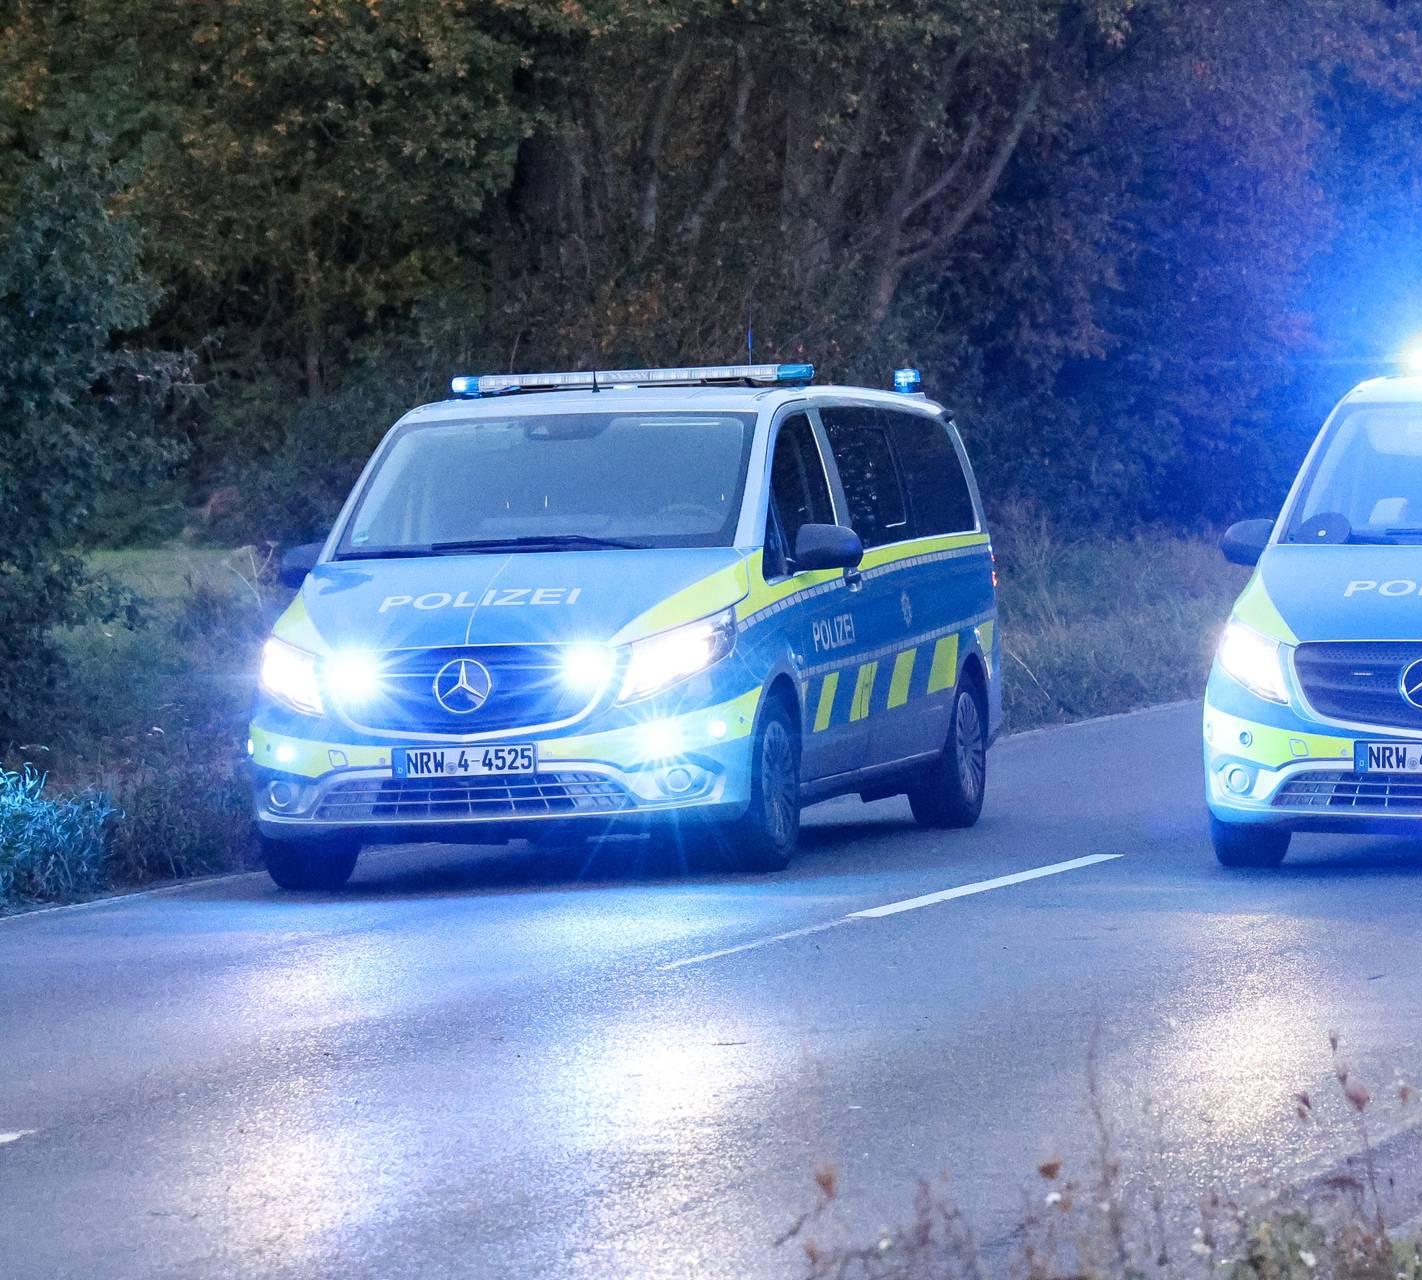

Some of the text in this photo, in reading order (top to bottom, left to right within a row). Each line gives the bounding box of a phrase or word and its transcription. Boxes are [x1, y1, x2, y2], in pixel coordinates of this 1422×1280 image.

[378, 587, 582, 613] POLIZEI
[812, 613, 856, 653] POLIZEI
[406, 748, 533, 774] NRW 4-4525
[1368, 746, 1407, 769] NRW
